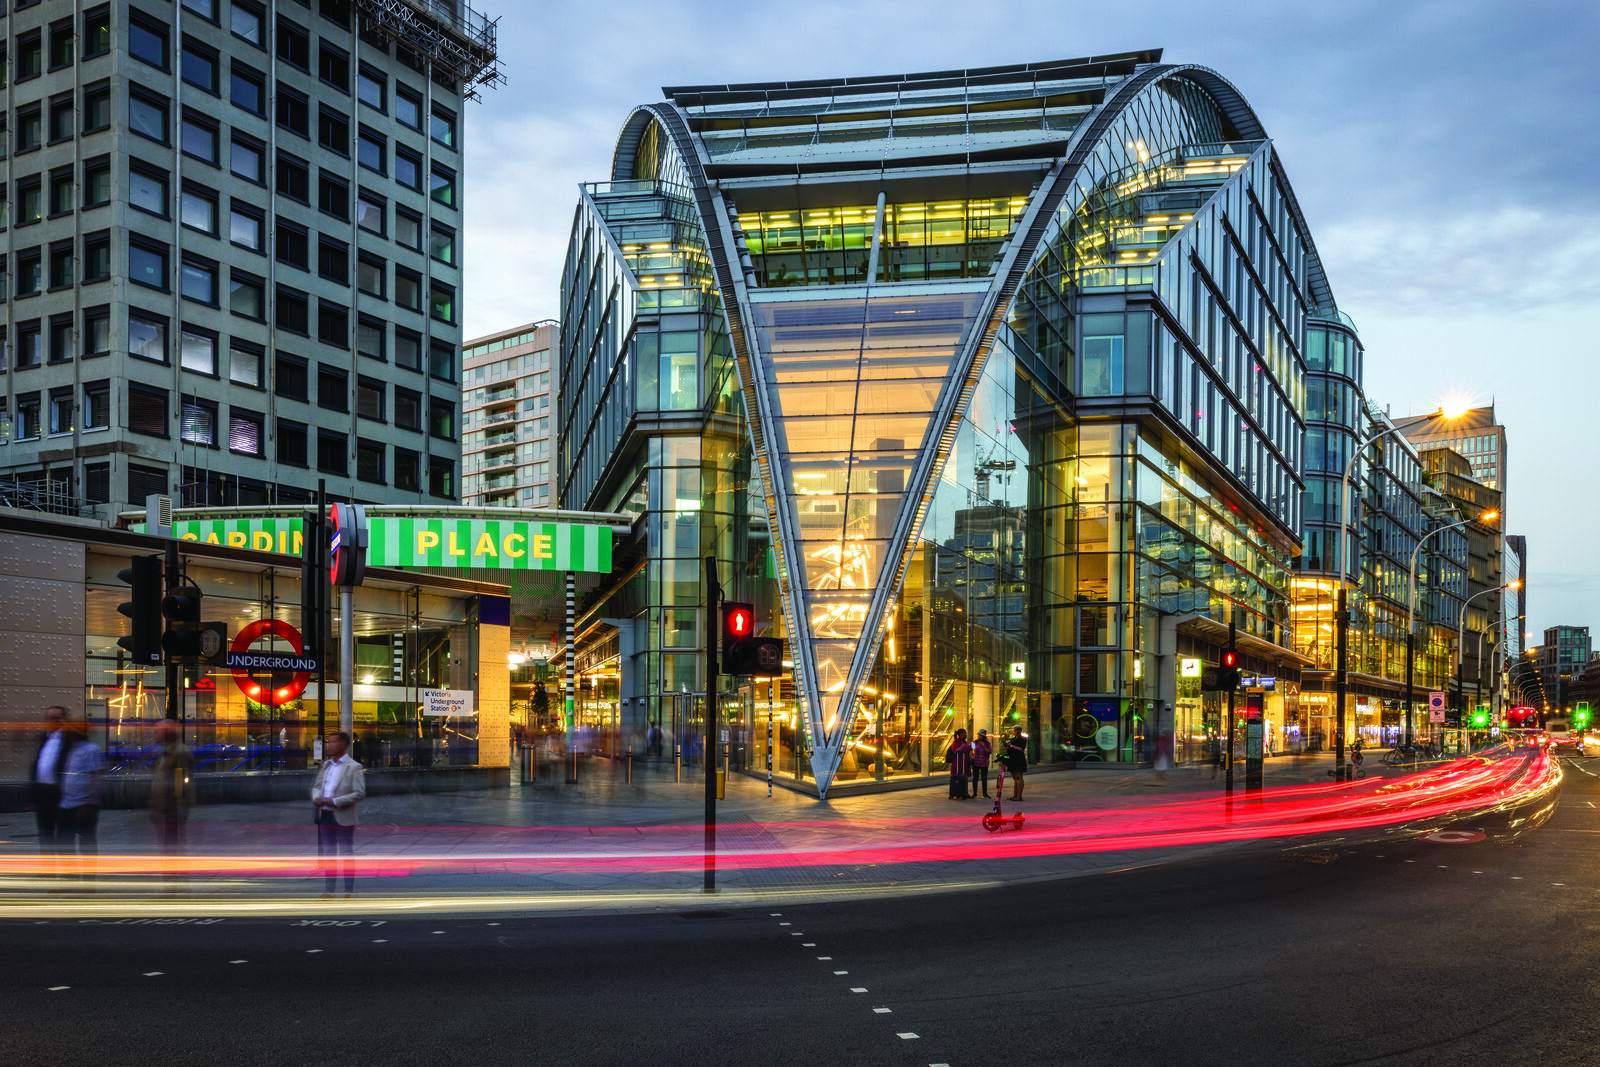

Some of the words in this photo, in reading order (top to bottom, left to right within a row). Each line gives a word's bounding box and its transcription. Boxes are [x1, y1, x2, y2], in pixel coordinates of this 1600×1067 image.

[417, 530, 553, 558] PLACE
[227, 655, 316, 670] UNDERGROUND
[430, 698, 465, 706] Underground
[290, 919, 387, 927] LOOK
